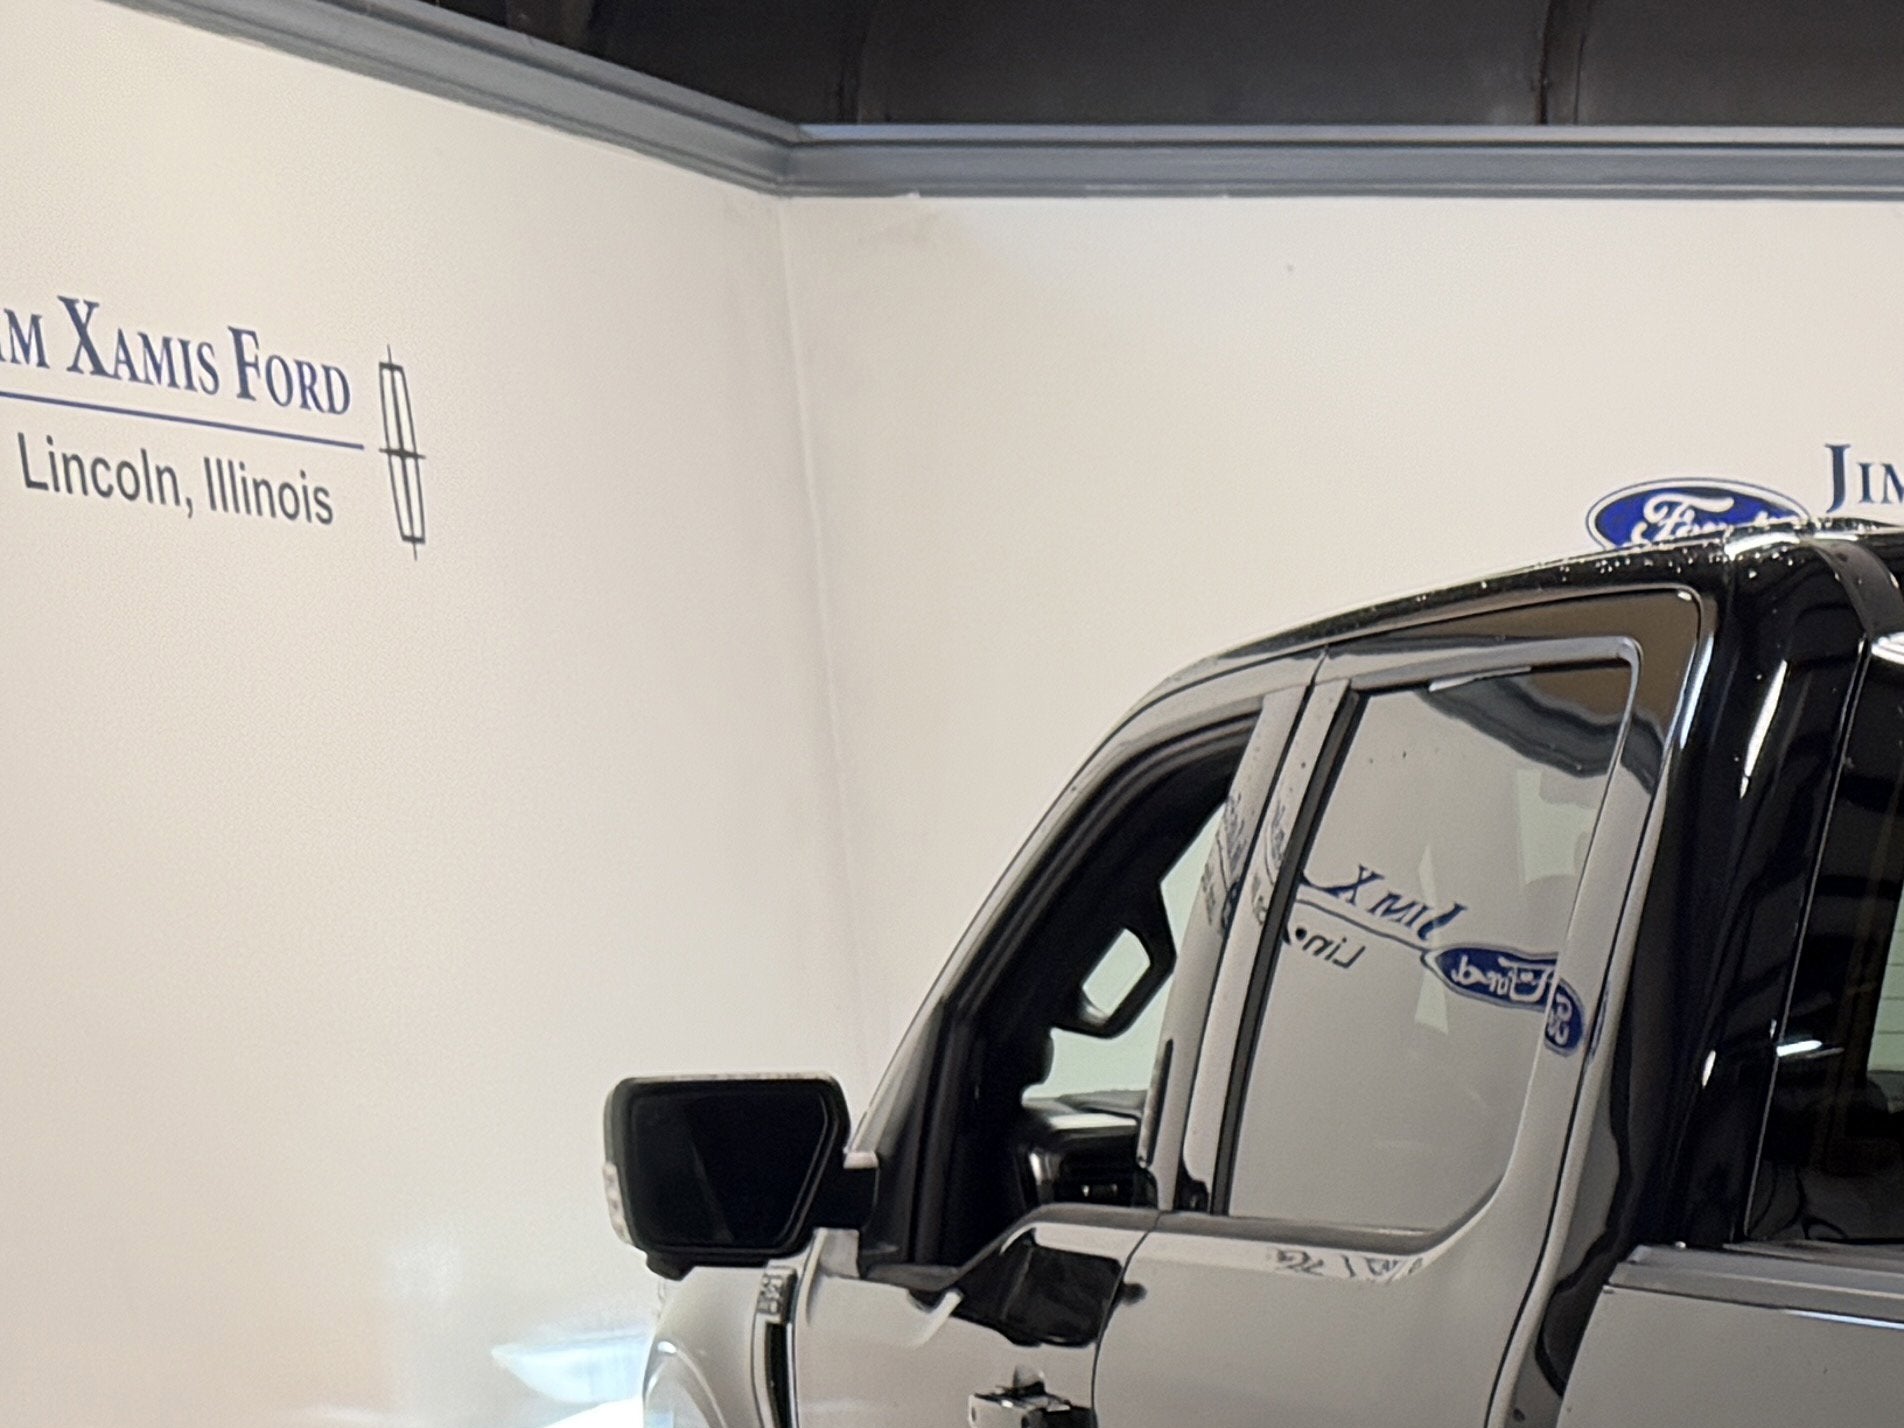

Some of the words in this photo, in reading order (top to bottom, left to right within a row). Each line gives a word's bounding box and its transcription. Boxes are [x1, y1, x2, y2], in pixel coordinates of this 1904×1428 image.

[57, 295, 220, 395] XAMIS
[228, 325, 351, 415] FORD
[18, 432, 193, 518] Lincoln,
[204, 457, 333, 525] Illinois
